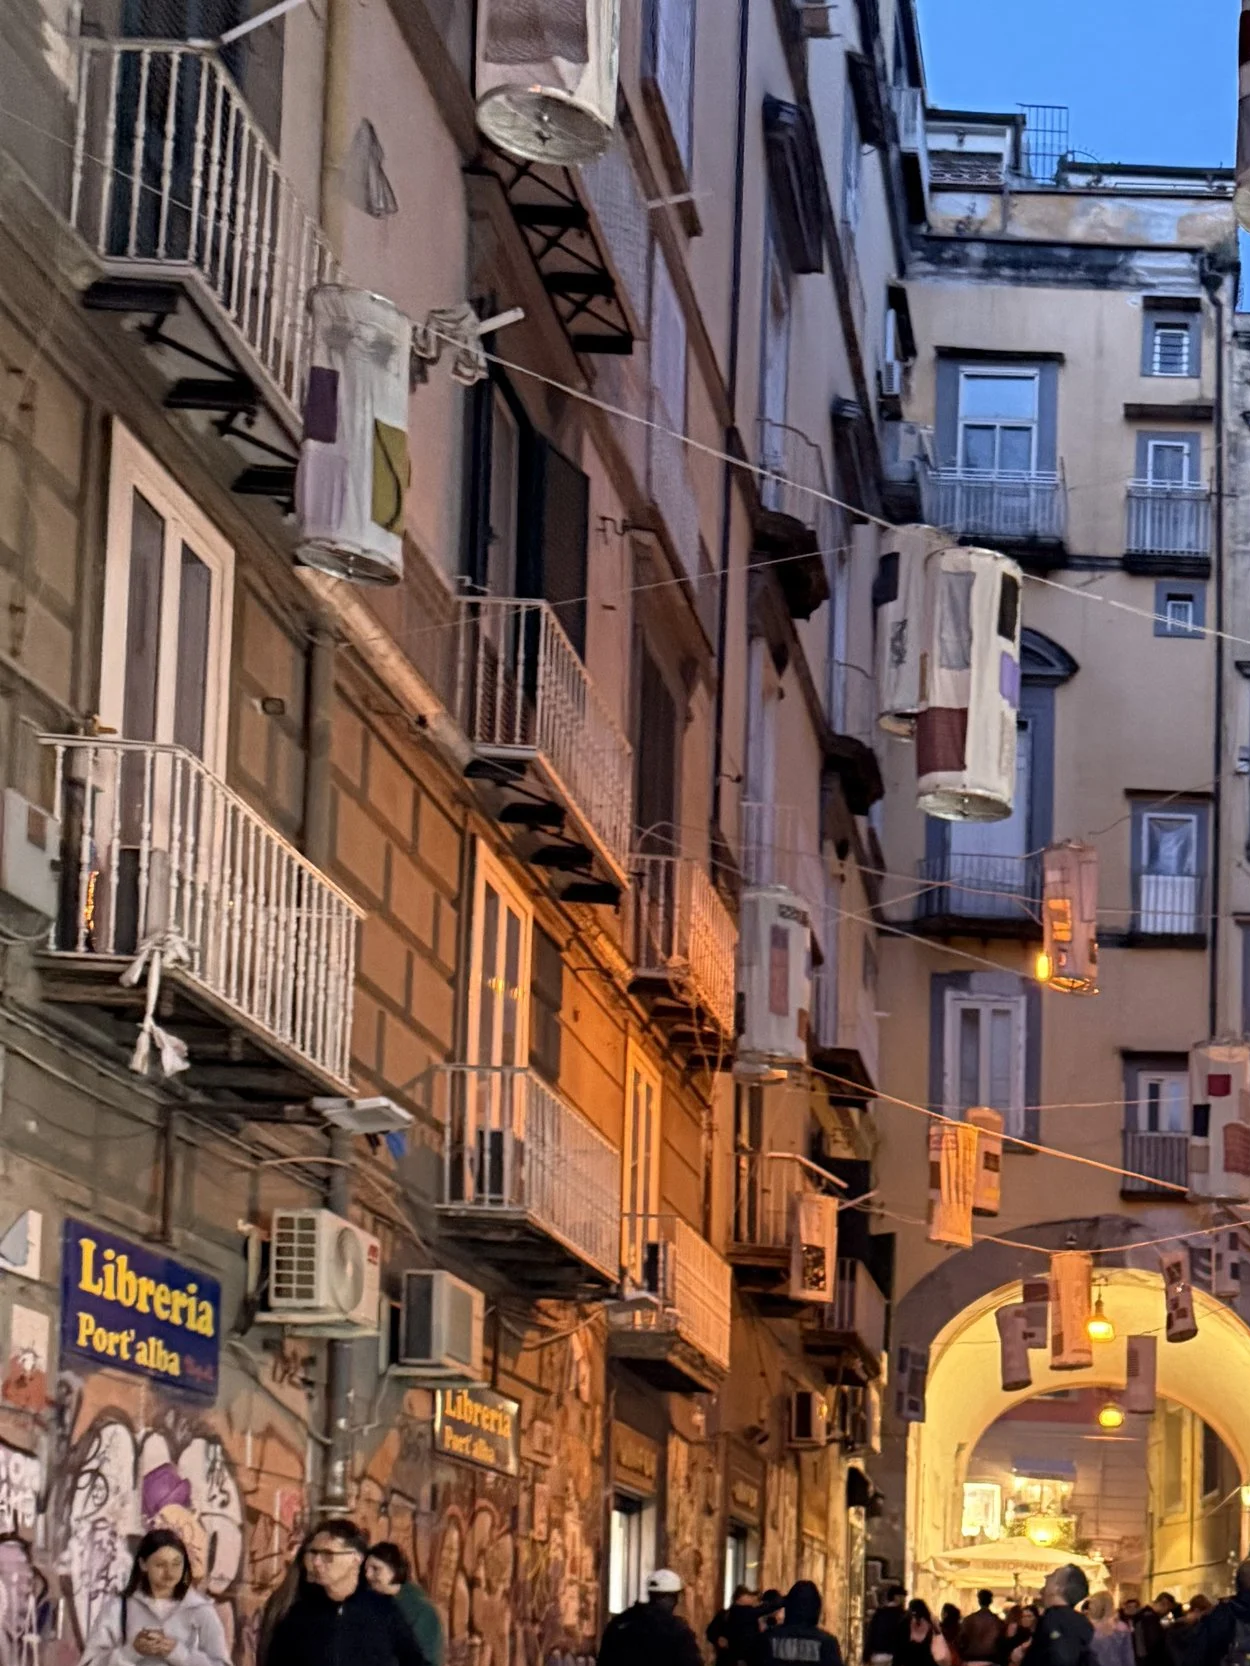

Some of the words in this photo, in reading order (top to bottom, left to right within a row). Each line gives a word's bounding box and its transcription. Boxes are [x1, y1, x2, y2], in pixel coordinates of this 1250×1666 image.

[78, 1238, 215, 1338] Libreria
[76, 1312, 181, 1377] Port'alba
[444, 1389, 512, 1439] Libreria
